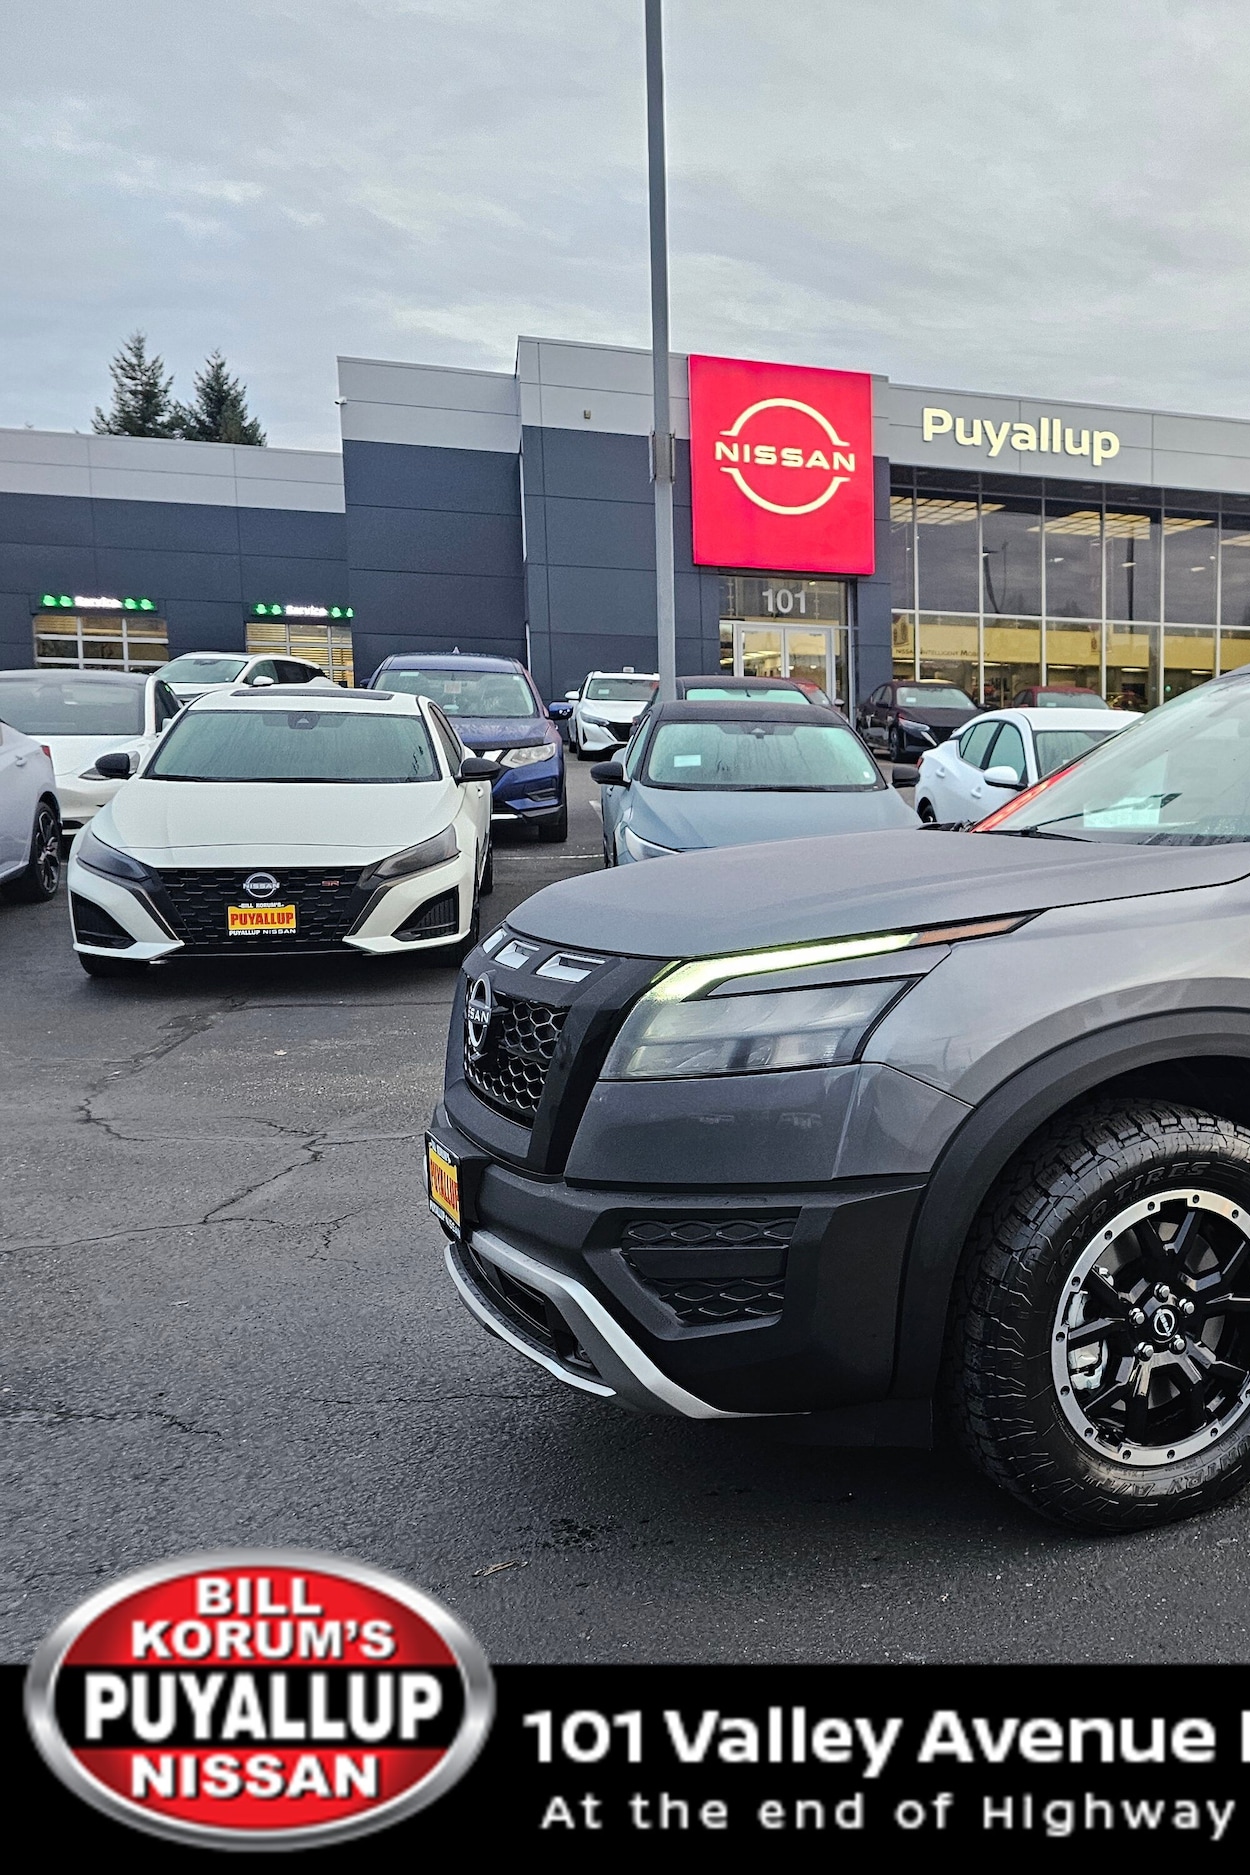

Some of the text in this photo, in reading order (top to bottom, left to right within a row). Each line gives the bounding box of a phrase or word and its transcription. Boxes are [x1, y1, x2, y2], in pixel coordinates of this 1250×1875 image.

[922, 408, 1120, 466] Puyallup
[715, 441, 855, 473] NISSAN
[762, 589, 806, 615] 101
[243, 882, 280, 890] NISSAN
[230, 912, 294, 926] PUYALLUP
